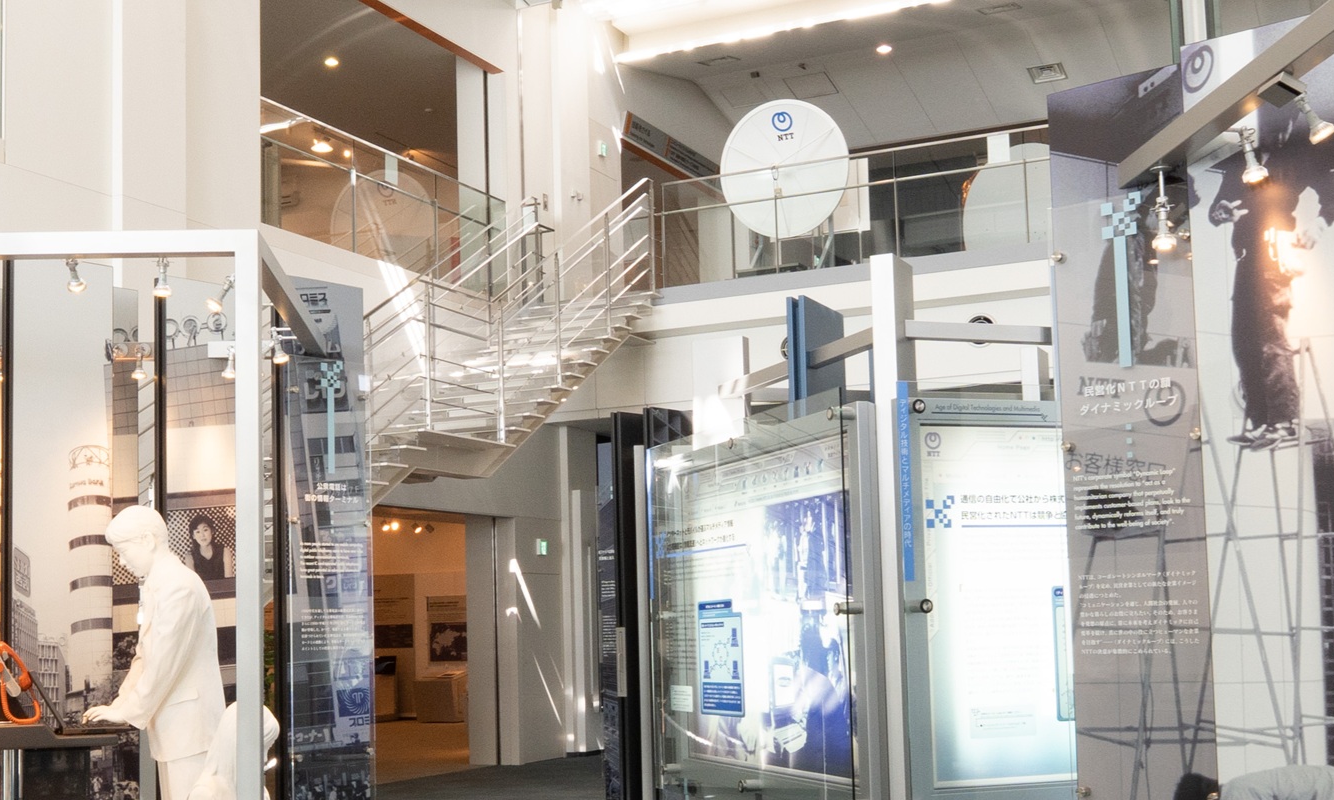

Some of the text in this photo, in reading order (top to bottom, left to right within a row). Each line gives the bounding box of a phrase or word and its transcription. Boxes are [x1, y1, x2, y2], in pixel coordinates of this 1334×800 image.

[777, 132, 795, 142] NTT
[935, 404, 946, 412] Age
[953, 404, 969, 412] Digital
[970, 404, 1002, 413] Technologies
[1080, 395, 1178, 416] ダイナミックループ
[1088, 474, 1113, 482] corporate
[1114, 472, 1132, 480] symbol
[1109, 481, 1134, 489] resolution
[304, 494, 359, 504] 街の情報ターミナル
[1108, 492, 1132, 500] company
[1144, 488, 1174, 498] perpetually
[1074, 503, 1103, 511] implements
[1103, 500, 1143, 509] customer-based
[1092, 511, 1123, 520] dynamically
[1123, 509, 1144, 517] reforms
[1171, 507, 1185, 516] truly
[1075, 522, 1100, 530] contribute
[1116, 519, 1143, 528] well-being
